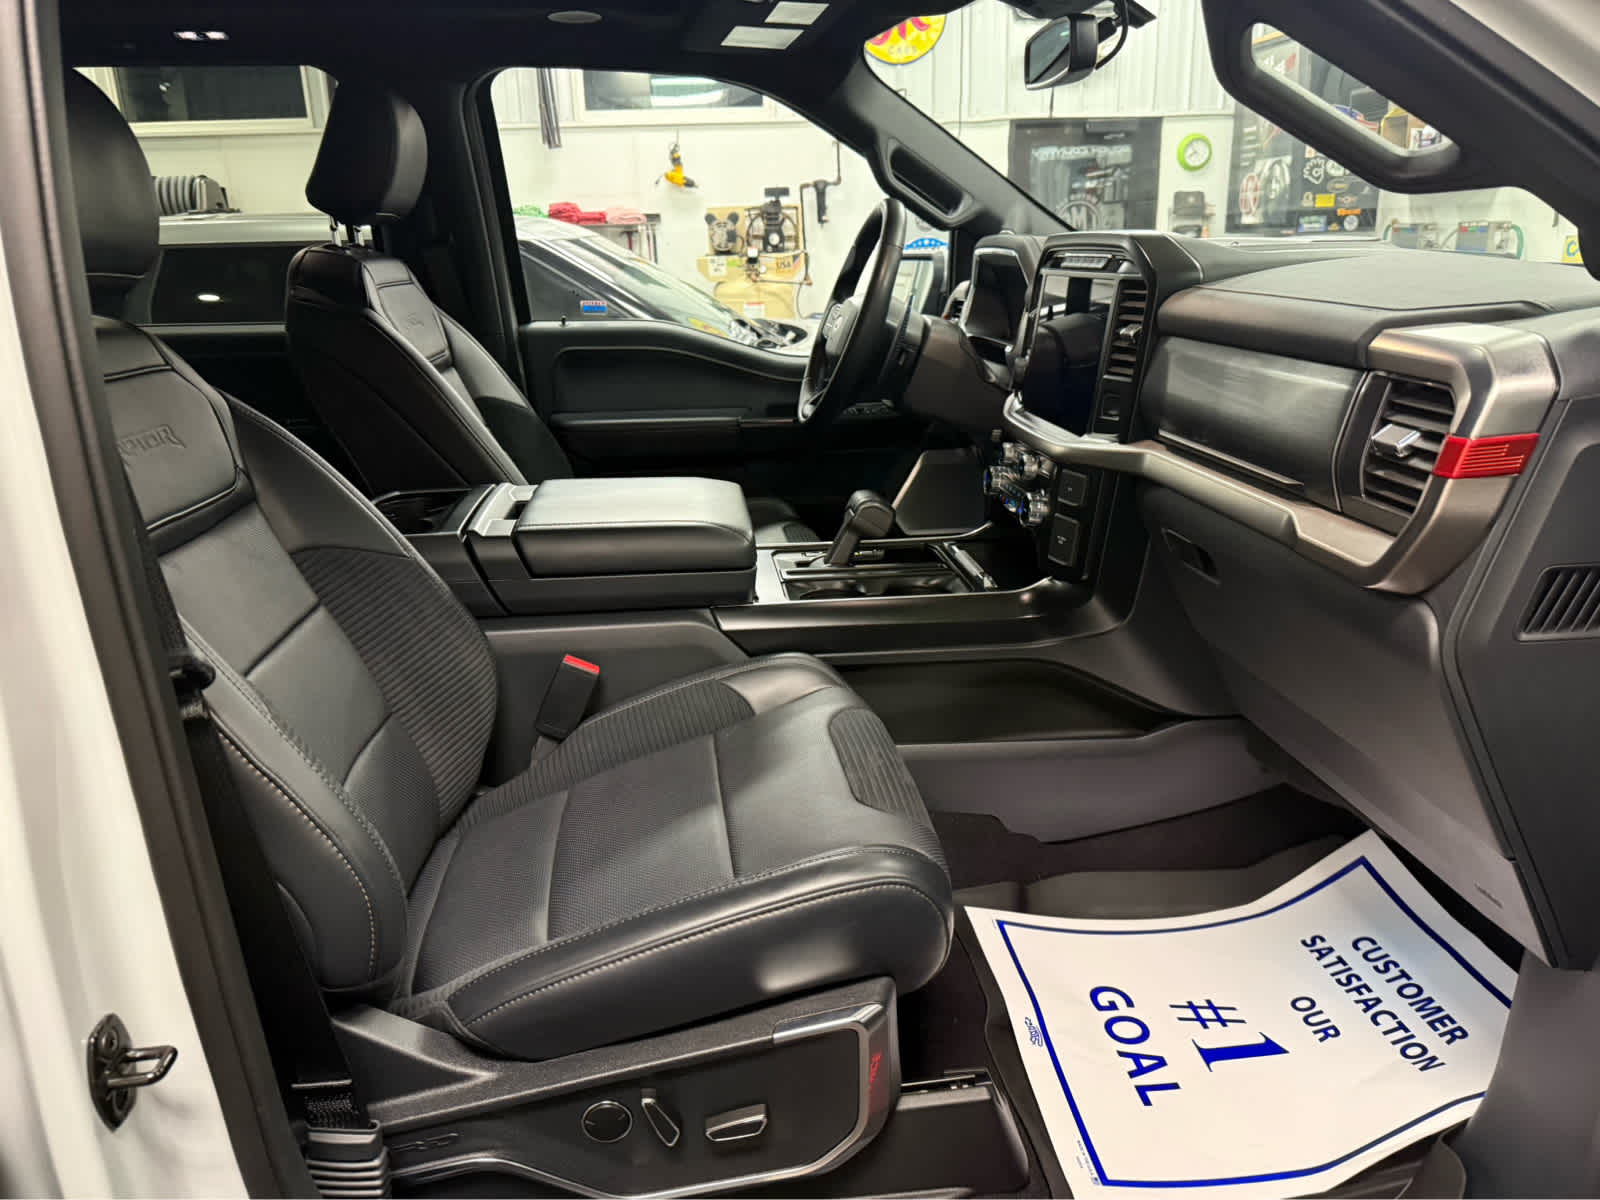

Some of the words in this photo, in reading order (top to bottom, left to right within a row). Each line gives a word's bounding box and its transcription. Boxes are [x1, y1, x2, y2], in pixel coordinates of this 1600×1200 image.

[1089, 985, 1181, 1107] GOAL
[1169, 999, 1290, 1073] #1
[1290, 996, 1341, 1043] OUR
[1300, 934, 1446, 1072] SATISFACTION
[1351, 936, 1469, 1046] CUSTOMER
